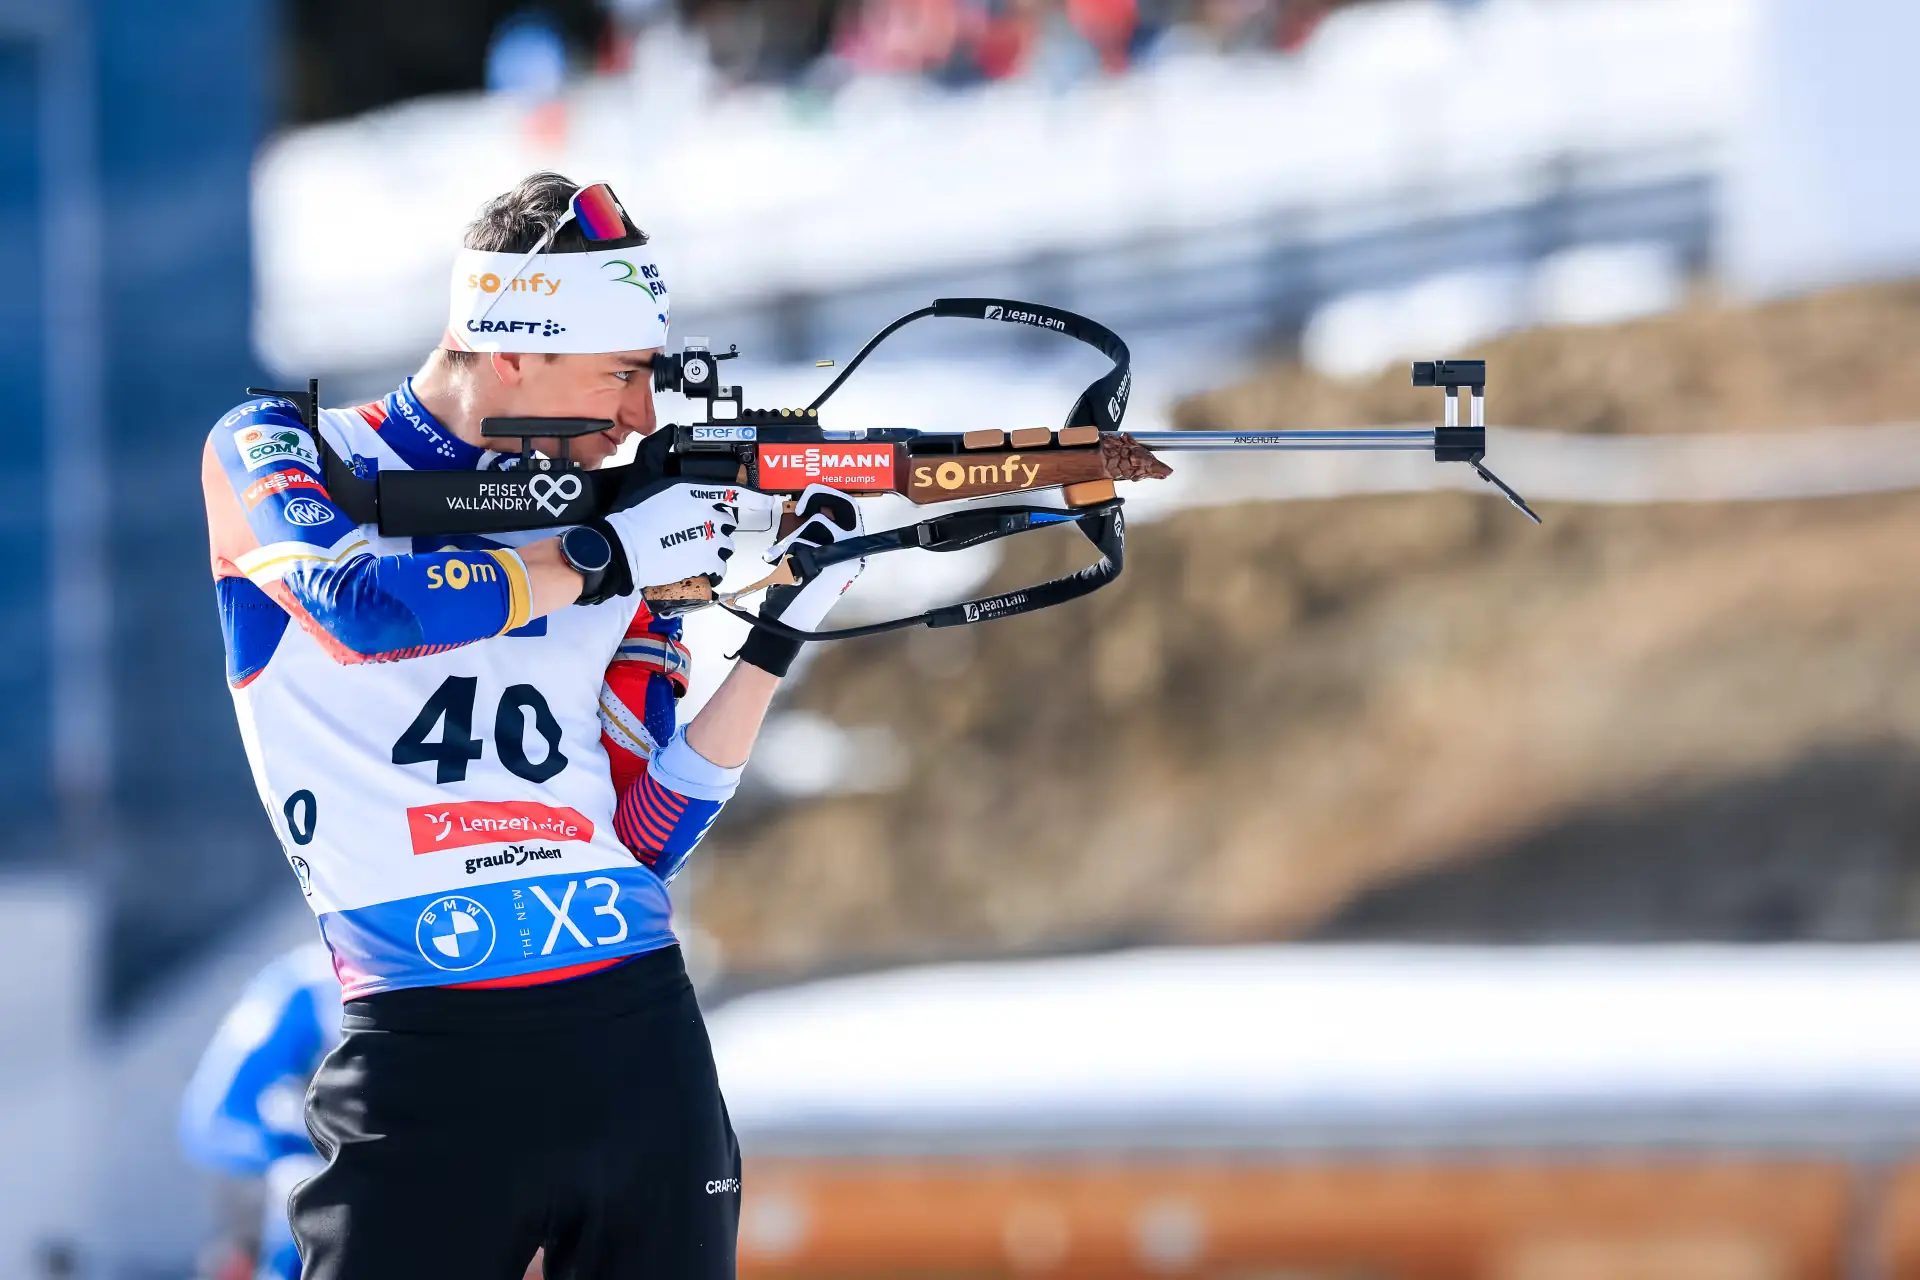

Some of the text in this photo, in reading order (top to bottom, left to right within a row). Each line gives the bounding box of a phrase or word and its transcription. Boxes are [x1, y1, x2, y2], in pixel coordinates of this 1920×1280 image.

[466, 319, 541, 334] CRAFT
[396, 393, 443, 443] CRAFT
[763, 448, 890, 477] VIESSMANN
[913, 455, 1040, 490] somfy
[247, 473, 320, 499] VIESSMA
[479, 484, 527, 497] PEISEY
[821, 475, 876, 484] Heat pumps
[289, 502, 330, 524] RWS
[446, 497, 532, 511] VALLANDRY
[391, 675, 569, 784] 40
[423, 899, 481, 926] BMW
[511, 889, 534, 958] THE NEW
[528, 876, 629, 957] X3
